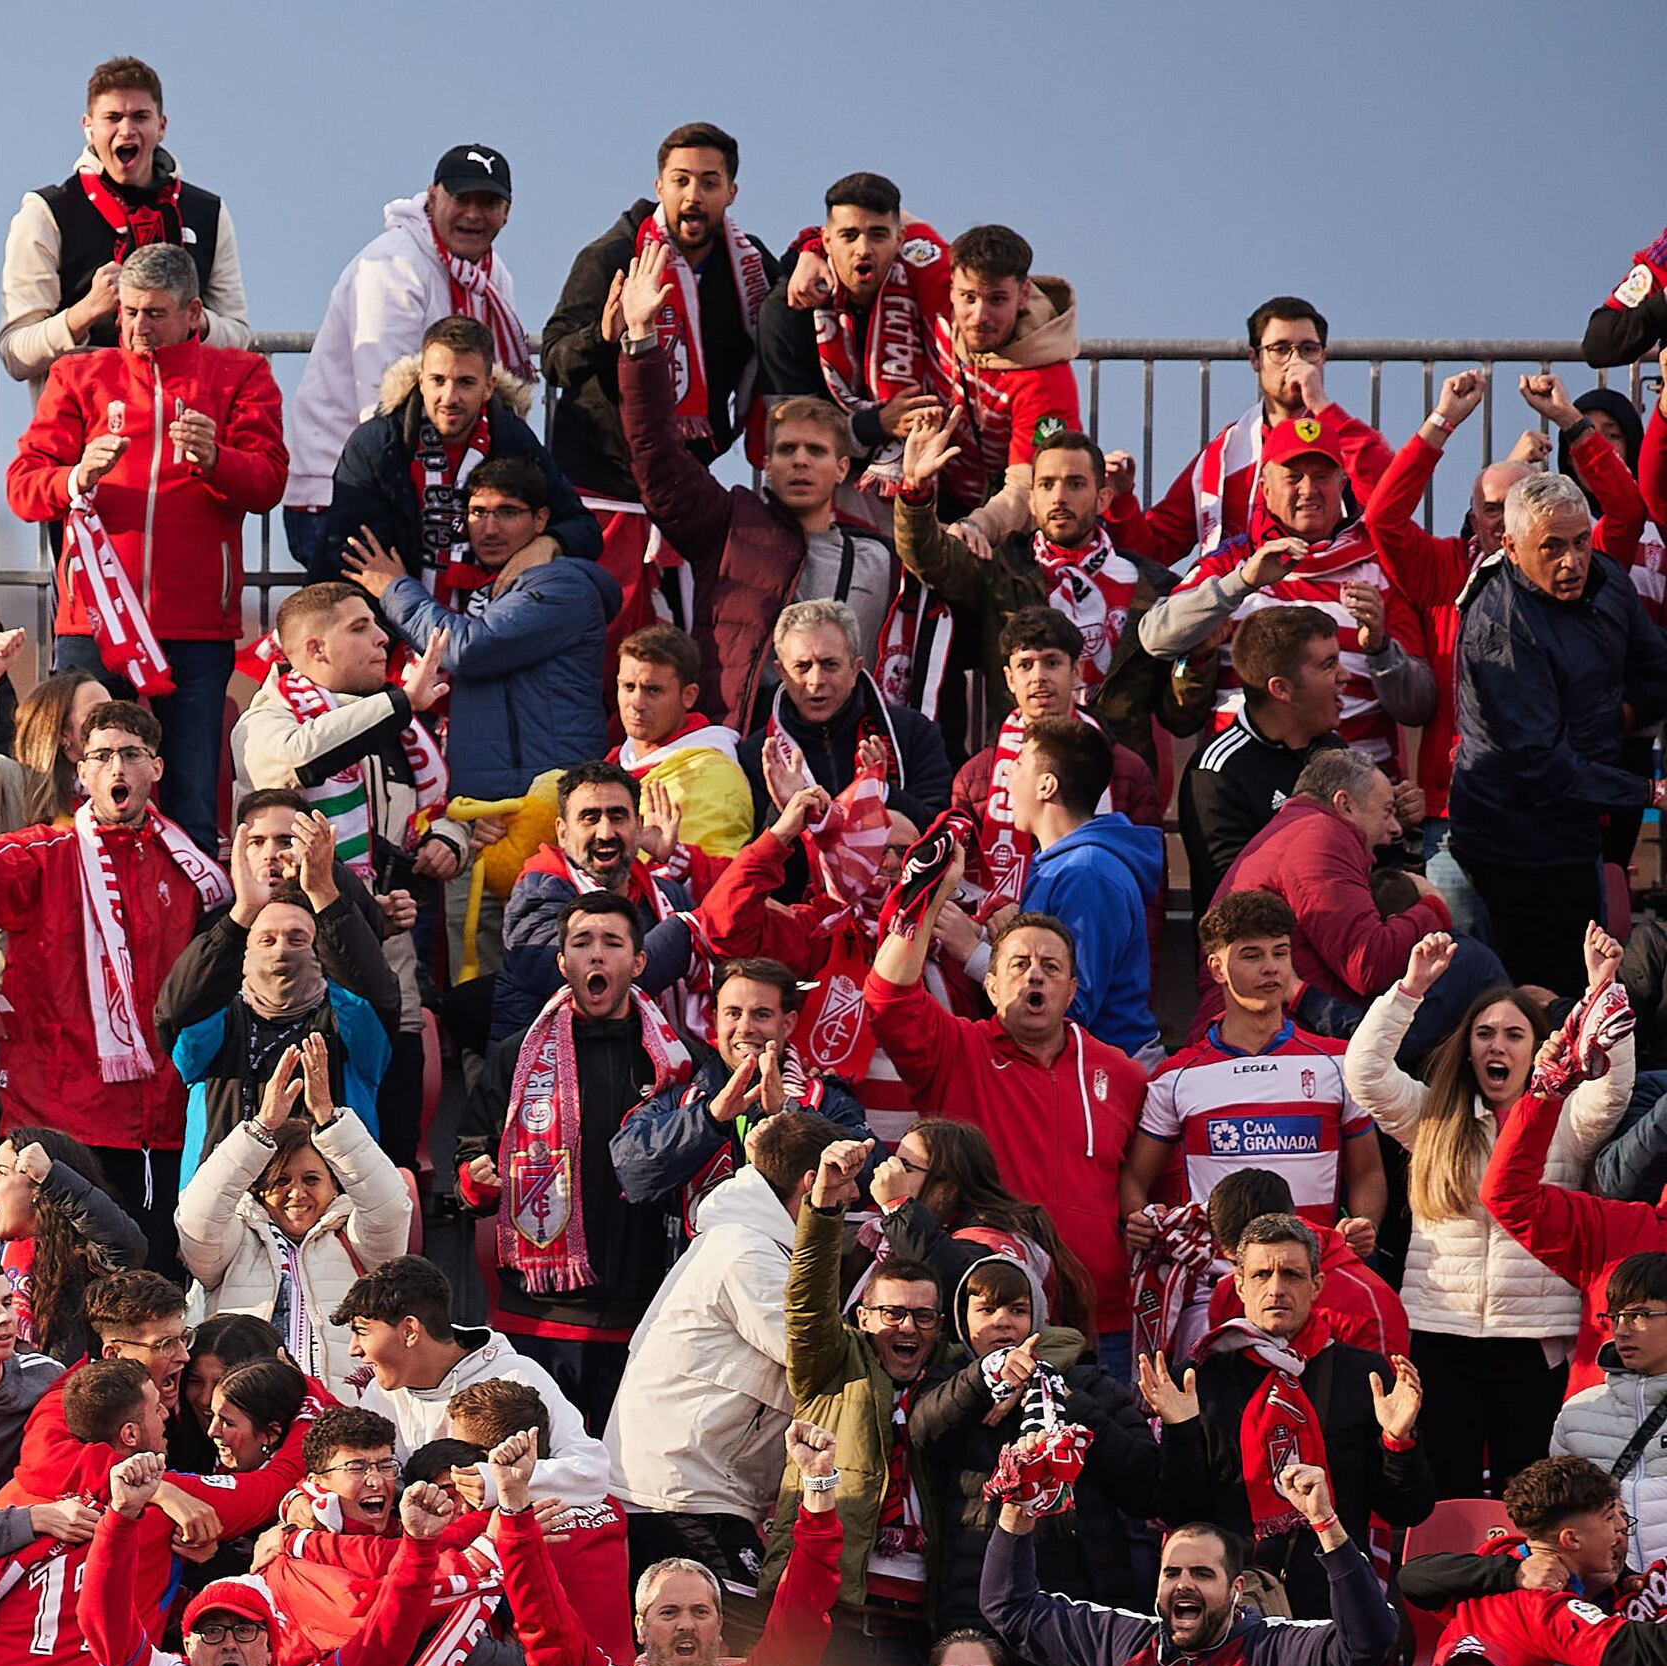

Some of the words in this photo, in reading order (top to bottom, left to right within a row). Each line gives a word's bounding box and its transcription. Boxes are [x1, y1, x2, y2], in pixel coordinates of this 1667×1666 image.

[1233, 1063, 1279, 1075] LEGEA
[1243, 1119, 1276, 1136] CAJA
[1243, 1134, 1318, 1152] GRANADA
